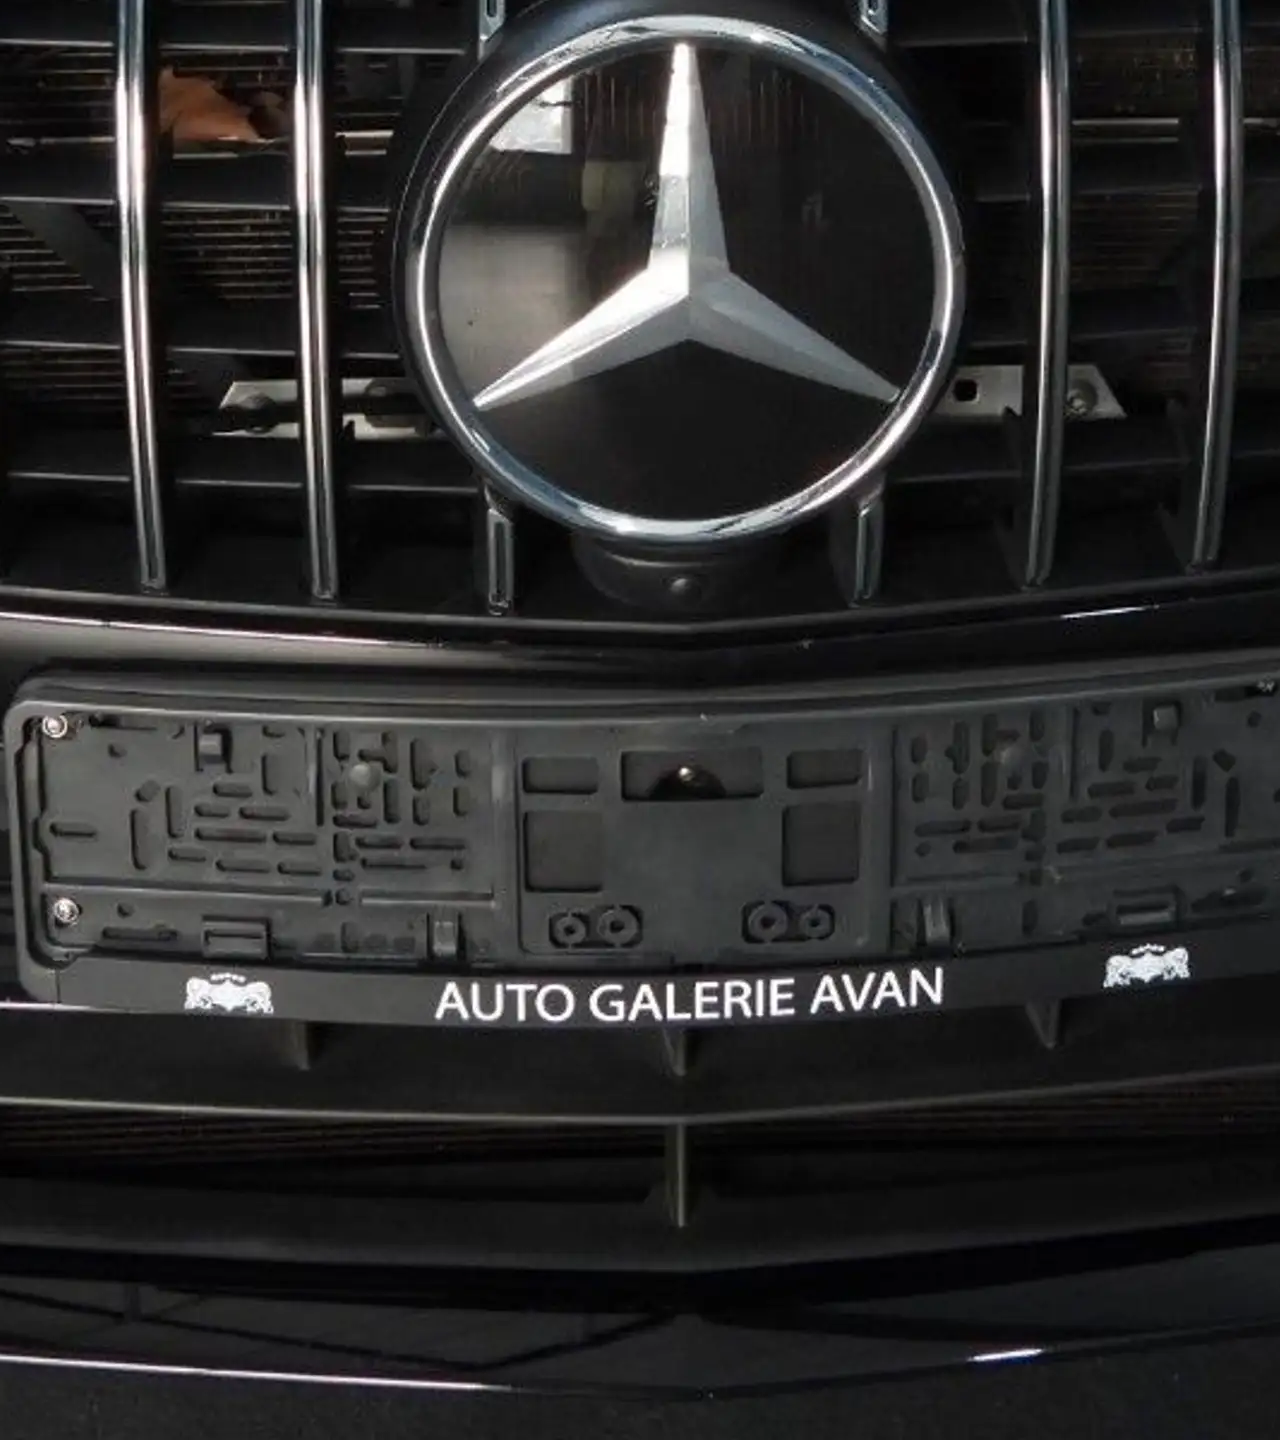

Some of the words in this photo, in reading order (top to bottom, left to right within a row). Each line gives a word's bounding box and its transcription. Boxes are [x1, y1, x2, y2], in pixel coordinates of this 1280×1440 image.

[434, 981, 575, 1022] AUTO
[588, 977, 795, 1022] GALERIE
[809, 966, 944, 1014] AVAN
